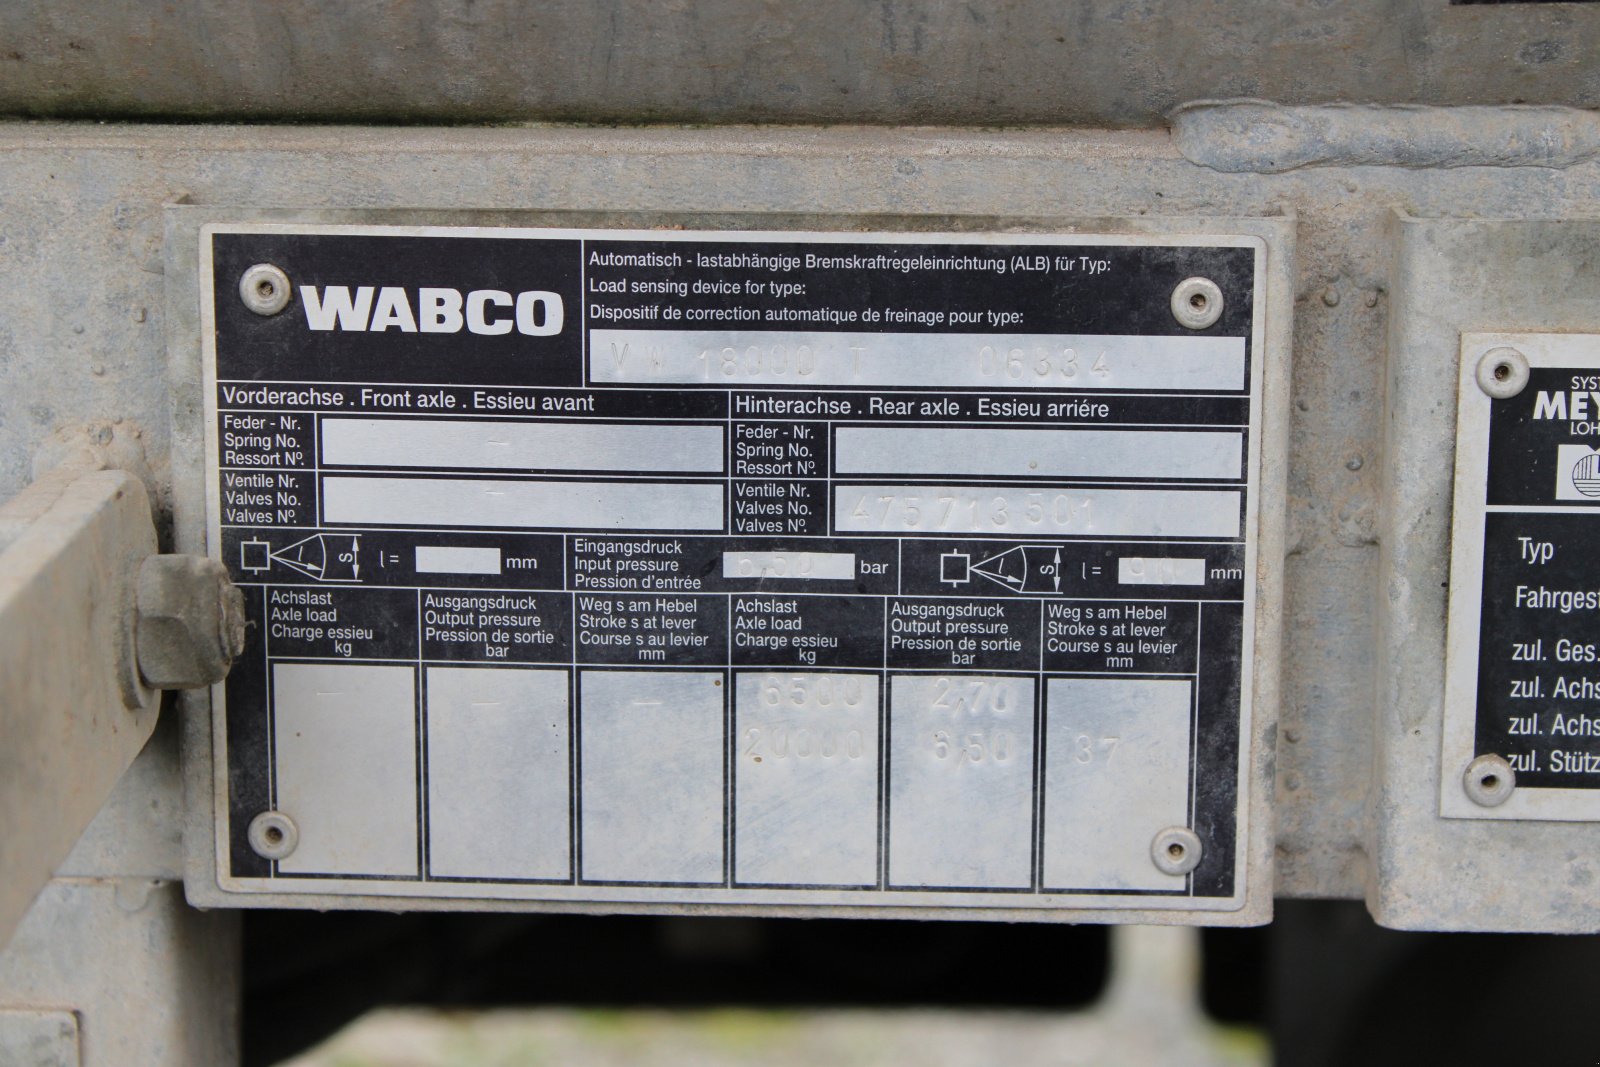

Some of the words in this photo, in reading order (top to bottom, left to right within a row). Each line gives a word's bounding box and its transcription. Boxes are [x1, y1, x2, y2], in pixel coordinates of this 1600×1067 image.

[589, 251, 682, 267] Automatisch
[697, 253, 801, 272] lastabhängige
[805, 254, 1006, 274] Bremskraftregeleinrichtung
[1010, 256, 1051, 275] (ALB)
[1055, 256, 1076, 271] für
[1080, 257, 1112, 275] Typ:
[590, 278, 626, 293] Load
[631, 280, 688, 297] sensing
[692, 280, 741, 295] device
[745, 280, 765, 295] for
[770, 283, 806, 297] type:
[300, 285, 564, 336] WABCO
[590, 304, 659, 322] Dispositif
[663, 305, 682, 320] de
[686, 306, 761, 321] correction
[765, 308, 857, 325] automatique
[862, 308, 881, 323] de
[885, 308, 945, 327] freinage
[949, 311, 983, 326] pour
[987, 311, 1024, 327] type:
[223, 386, 344, 406] Vorderachse
[361, 389, 411, 408] Front
[417, 391, 456, 409] axle
[474, 391, 535, 411] Essieu
[541, 394, 595, 412] avant
[736, 395, 851, 415] Hinterachse
[870, 399, 914, 416] Rear
[920, 399, 959, 417] axle
[978, 399, 1041, 418] Essieu
[1047, 400, 1110, 418] arriére
[224, 415, 266, 430] Feder
[280, 416, 301, 430] Nr.
[736, 425, 779, 439] Feder
[793, 426, 814, 440] Nr.
[224, 433, 272, 451] Spring
[276, 435, 300, 449] No.
[225, 451, 281, 466] Ressort
[736, 443, 784, 460] Spring
[789, 444, 813, 458] No.
[736, 460, 793, 475] Ressort
[225, 473, 274, 489] Ventile
[278, 474, 299, 489] Nr.
[736, 483, 785, 498] Ventile
[790, 484, 811, 498] Nr.
[226, 491, 273, 506] Valves
[278, 492, 301, 507] No.
[226, 508, 273, 523] Valves
[736, 501, 783, 515] Valves
[789, 502, 813, 516] No.
[736, 518, 783, 533] Valves
[574, 540, 683, 558] Eingangsdruck
[1518, 537, 1554, 565] Typ
[506, 556, 538, 571] mm
[574, 557, 613, 574] Input
[616, 559, 679, 575] pressure
[861, 560, 889, 575] bar
[574, 574, 637, 589] Pression
[1211, 567, 1242, 581] mm
[271, 590, 333, 606] Achslast
[425, 593, 537, 612] Ausgangsdruck
[579, 598, 612, 614] Weg
[616, 602, 624, 612] s
[628, 602, 651, 613] am
[655, 599, 698, 613] Hebel
[735, 598, 798, 613] Achslast
[271, 607, 302, 622] Axle
[306, 608, 337, 622] load
[891, 601, 1005, 621] Ausgangsdruck
[1048, 604, 1081, 621] Weg
[1085, 608, 1094, 619] s
[1098, 609, 1121, 620] am
[1125, 606, 1167, 620] Hebel
[425, 610, 474, 628] Output
[478, 614, 541, 629] pressure
[579, 614, 627, 629] Stroke
[631, 618, 639, 629] s
[643, 616, 657, 629] at
[662, 616, 697, 630] lever
[735, 615, 767, 630] Axle
[771, 616, 802, 631] load
[891, 618, 941, 635] Output
[945, 621, 1009, 636] pressure
[271, 623, 323, 641] Charge
[327, 625, 373, 640] essieu
[425, 628, 488, 643] Pression
[491, 629, 510, 643] de
[514, 630, 554, 644] sortie
[1048, 621, 1095, 636] Stroke
[1099, 625, 1108, 636] s
[1112, 623, 1126, 637] at
[1130, 622, 1166, 637] lever
[579, 631, 632, 646] Course
[635, 635, 644, 646] s
[648, 635, 665, 646] au
[670, 632, 709, 647] levier
[735, 633, 788, 650] Charge
[792, 634, 838, 648] essieu
[891, 636, 954, 650] Pression
[958, 637, 977, 651] de
[981, 637, 1022, 651] sortie
[1047, 638, 1099, 653] Course
[1103, 642, 1112, 653] s
[1116, 642, 1135, 654] au
[1138, 640, 1178, 655] levier
[335, 640, 352, 656] kg
[486, 643, 509, 657] bar
[638, 650, 665, 660] mm
[1512, 639, 1547, 661] zul.
[799, 648, 816, 665] kg
[952, 651, 976, 665] bar
[1106, 657, 1133, 668] mm
[1510, 676, 1545, 698] zul.
[1508, 713, 1543, 735] zul.
[1075, 734, 1120, 765] 37
[1507, 750, 1541, 772] zul.
